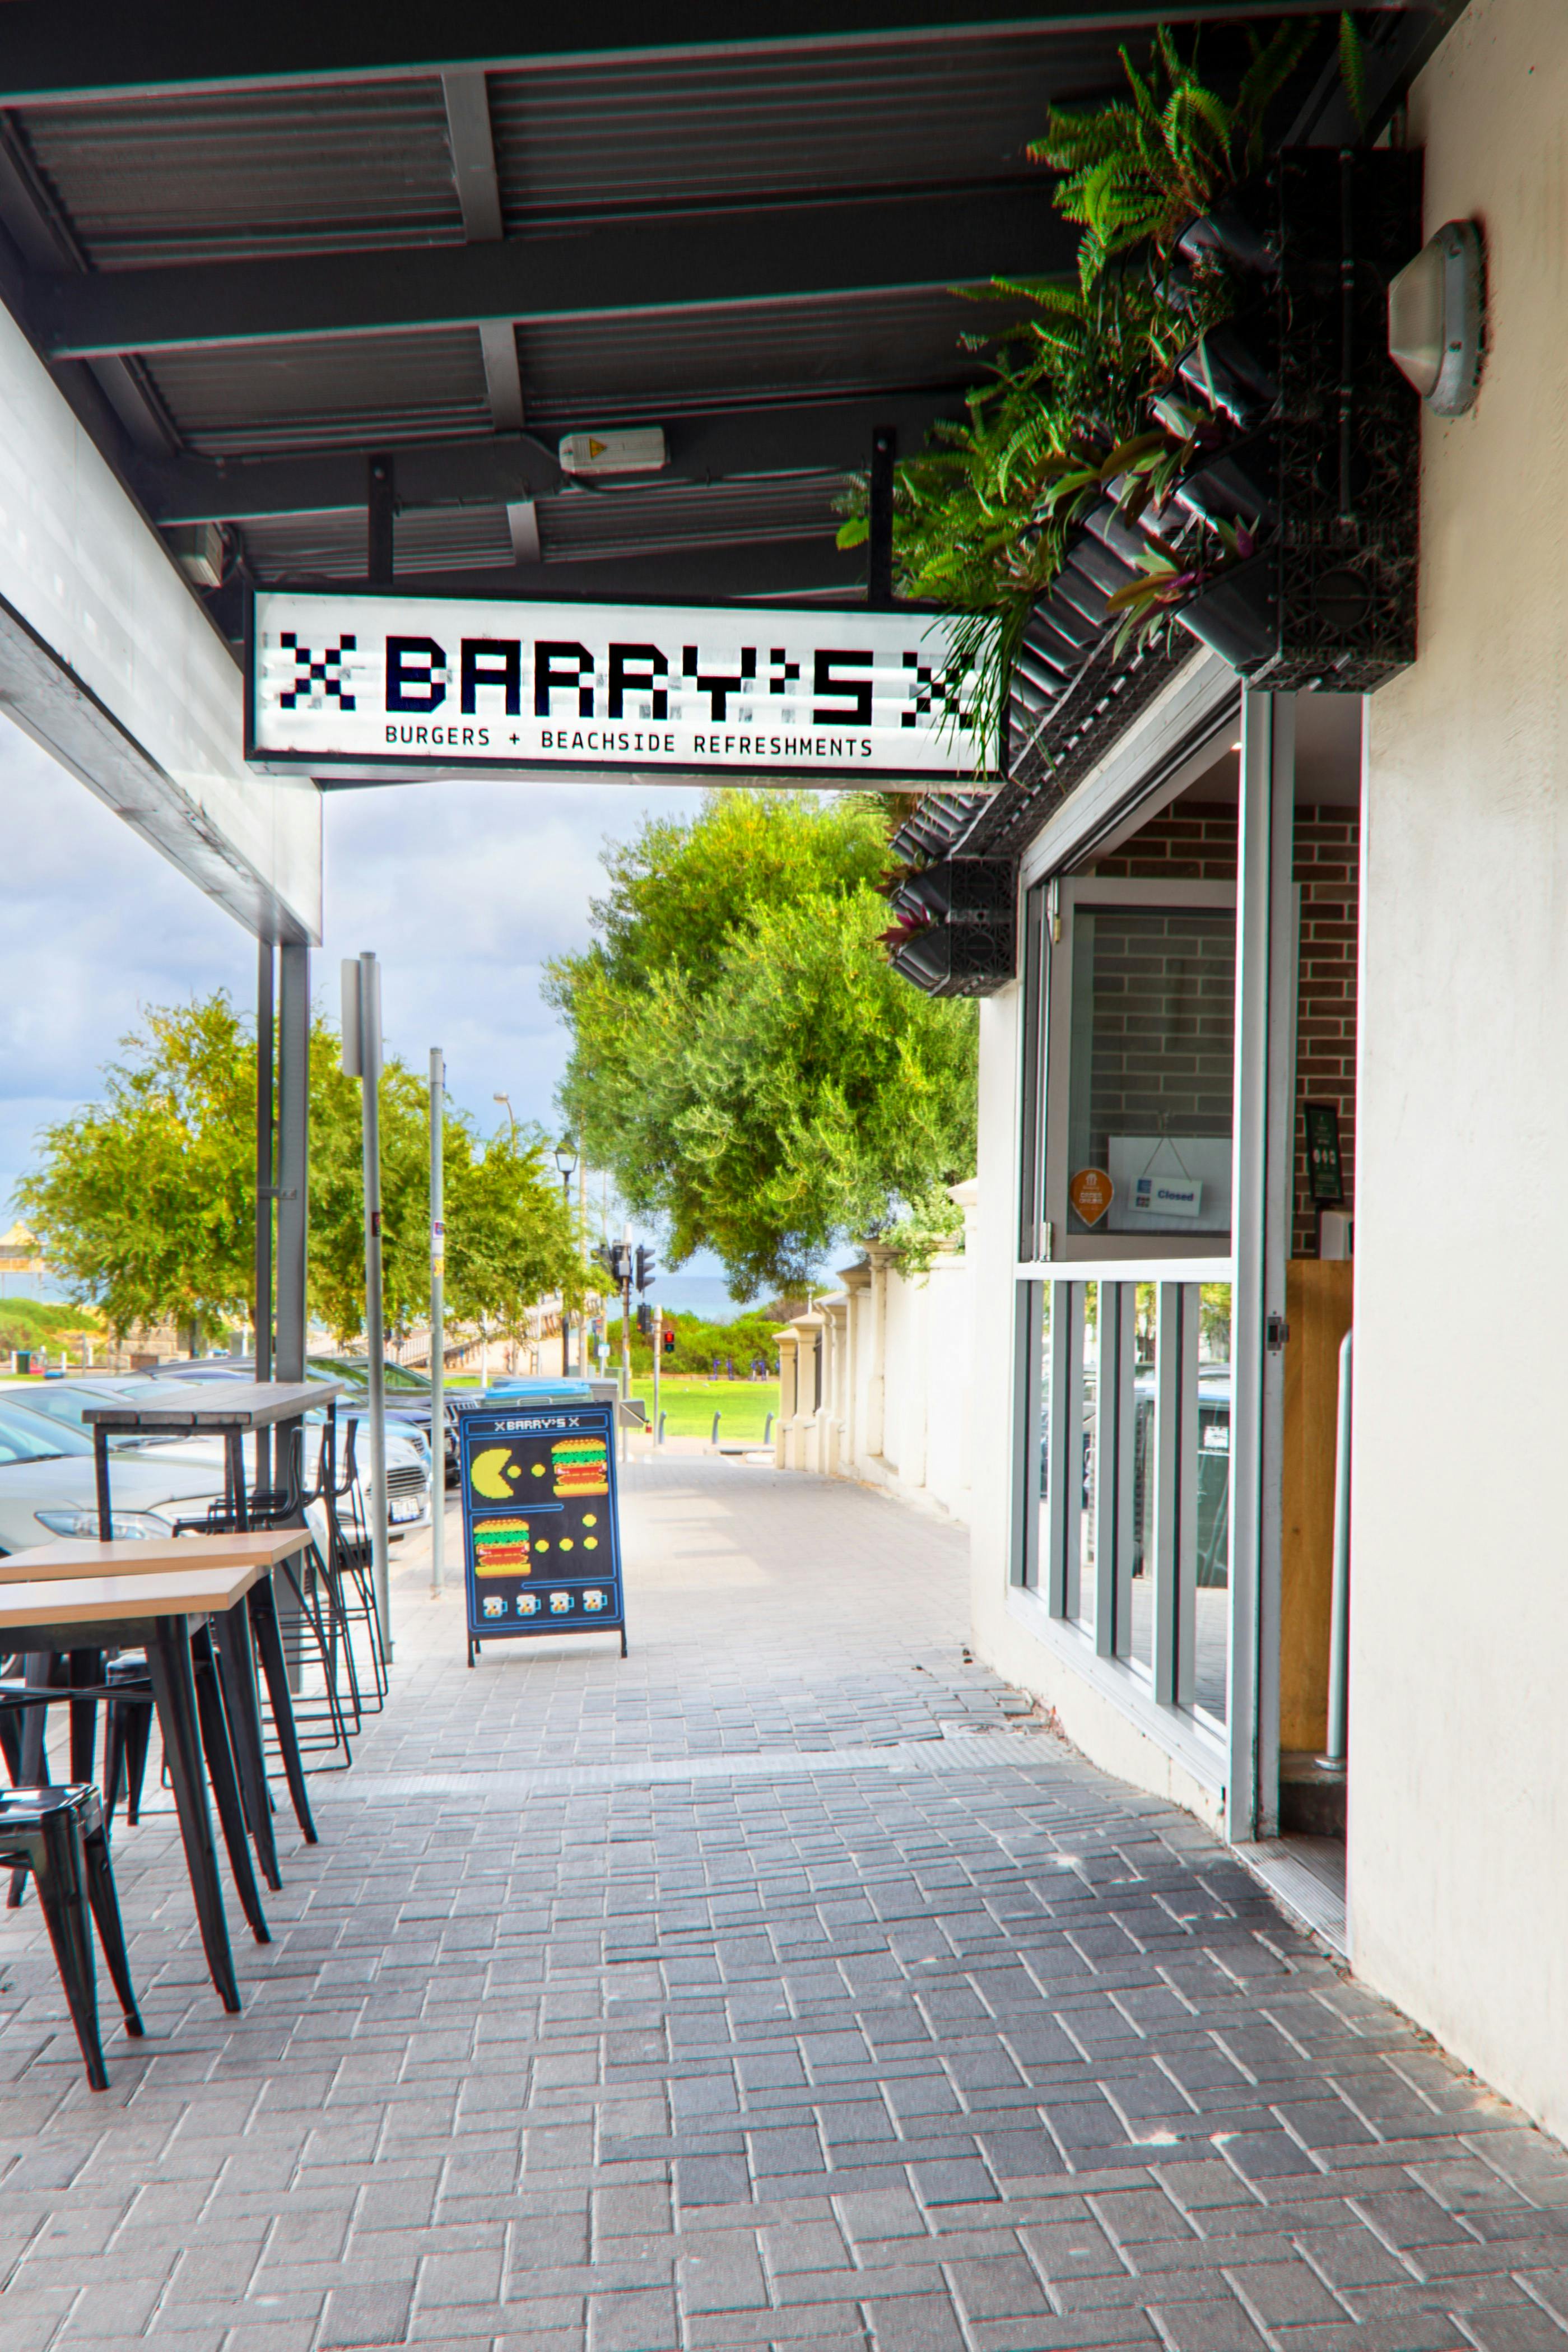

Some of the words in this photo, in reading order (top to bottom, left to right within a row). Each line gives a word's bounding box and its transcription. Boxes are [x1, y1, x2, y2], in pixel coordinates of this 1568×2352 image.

[385, 635, 873, 726] BARRY'S
[385, 726, 490, 746] BURGERS
[541, 731, 675, 753] BEACHSIDE
[694, 735, 872, 757] REFRESHMENTS
[1157, 1189, 1194, 1202] Closed
[506, 1417, 566, 1431] BARRY'S
